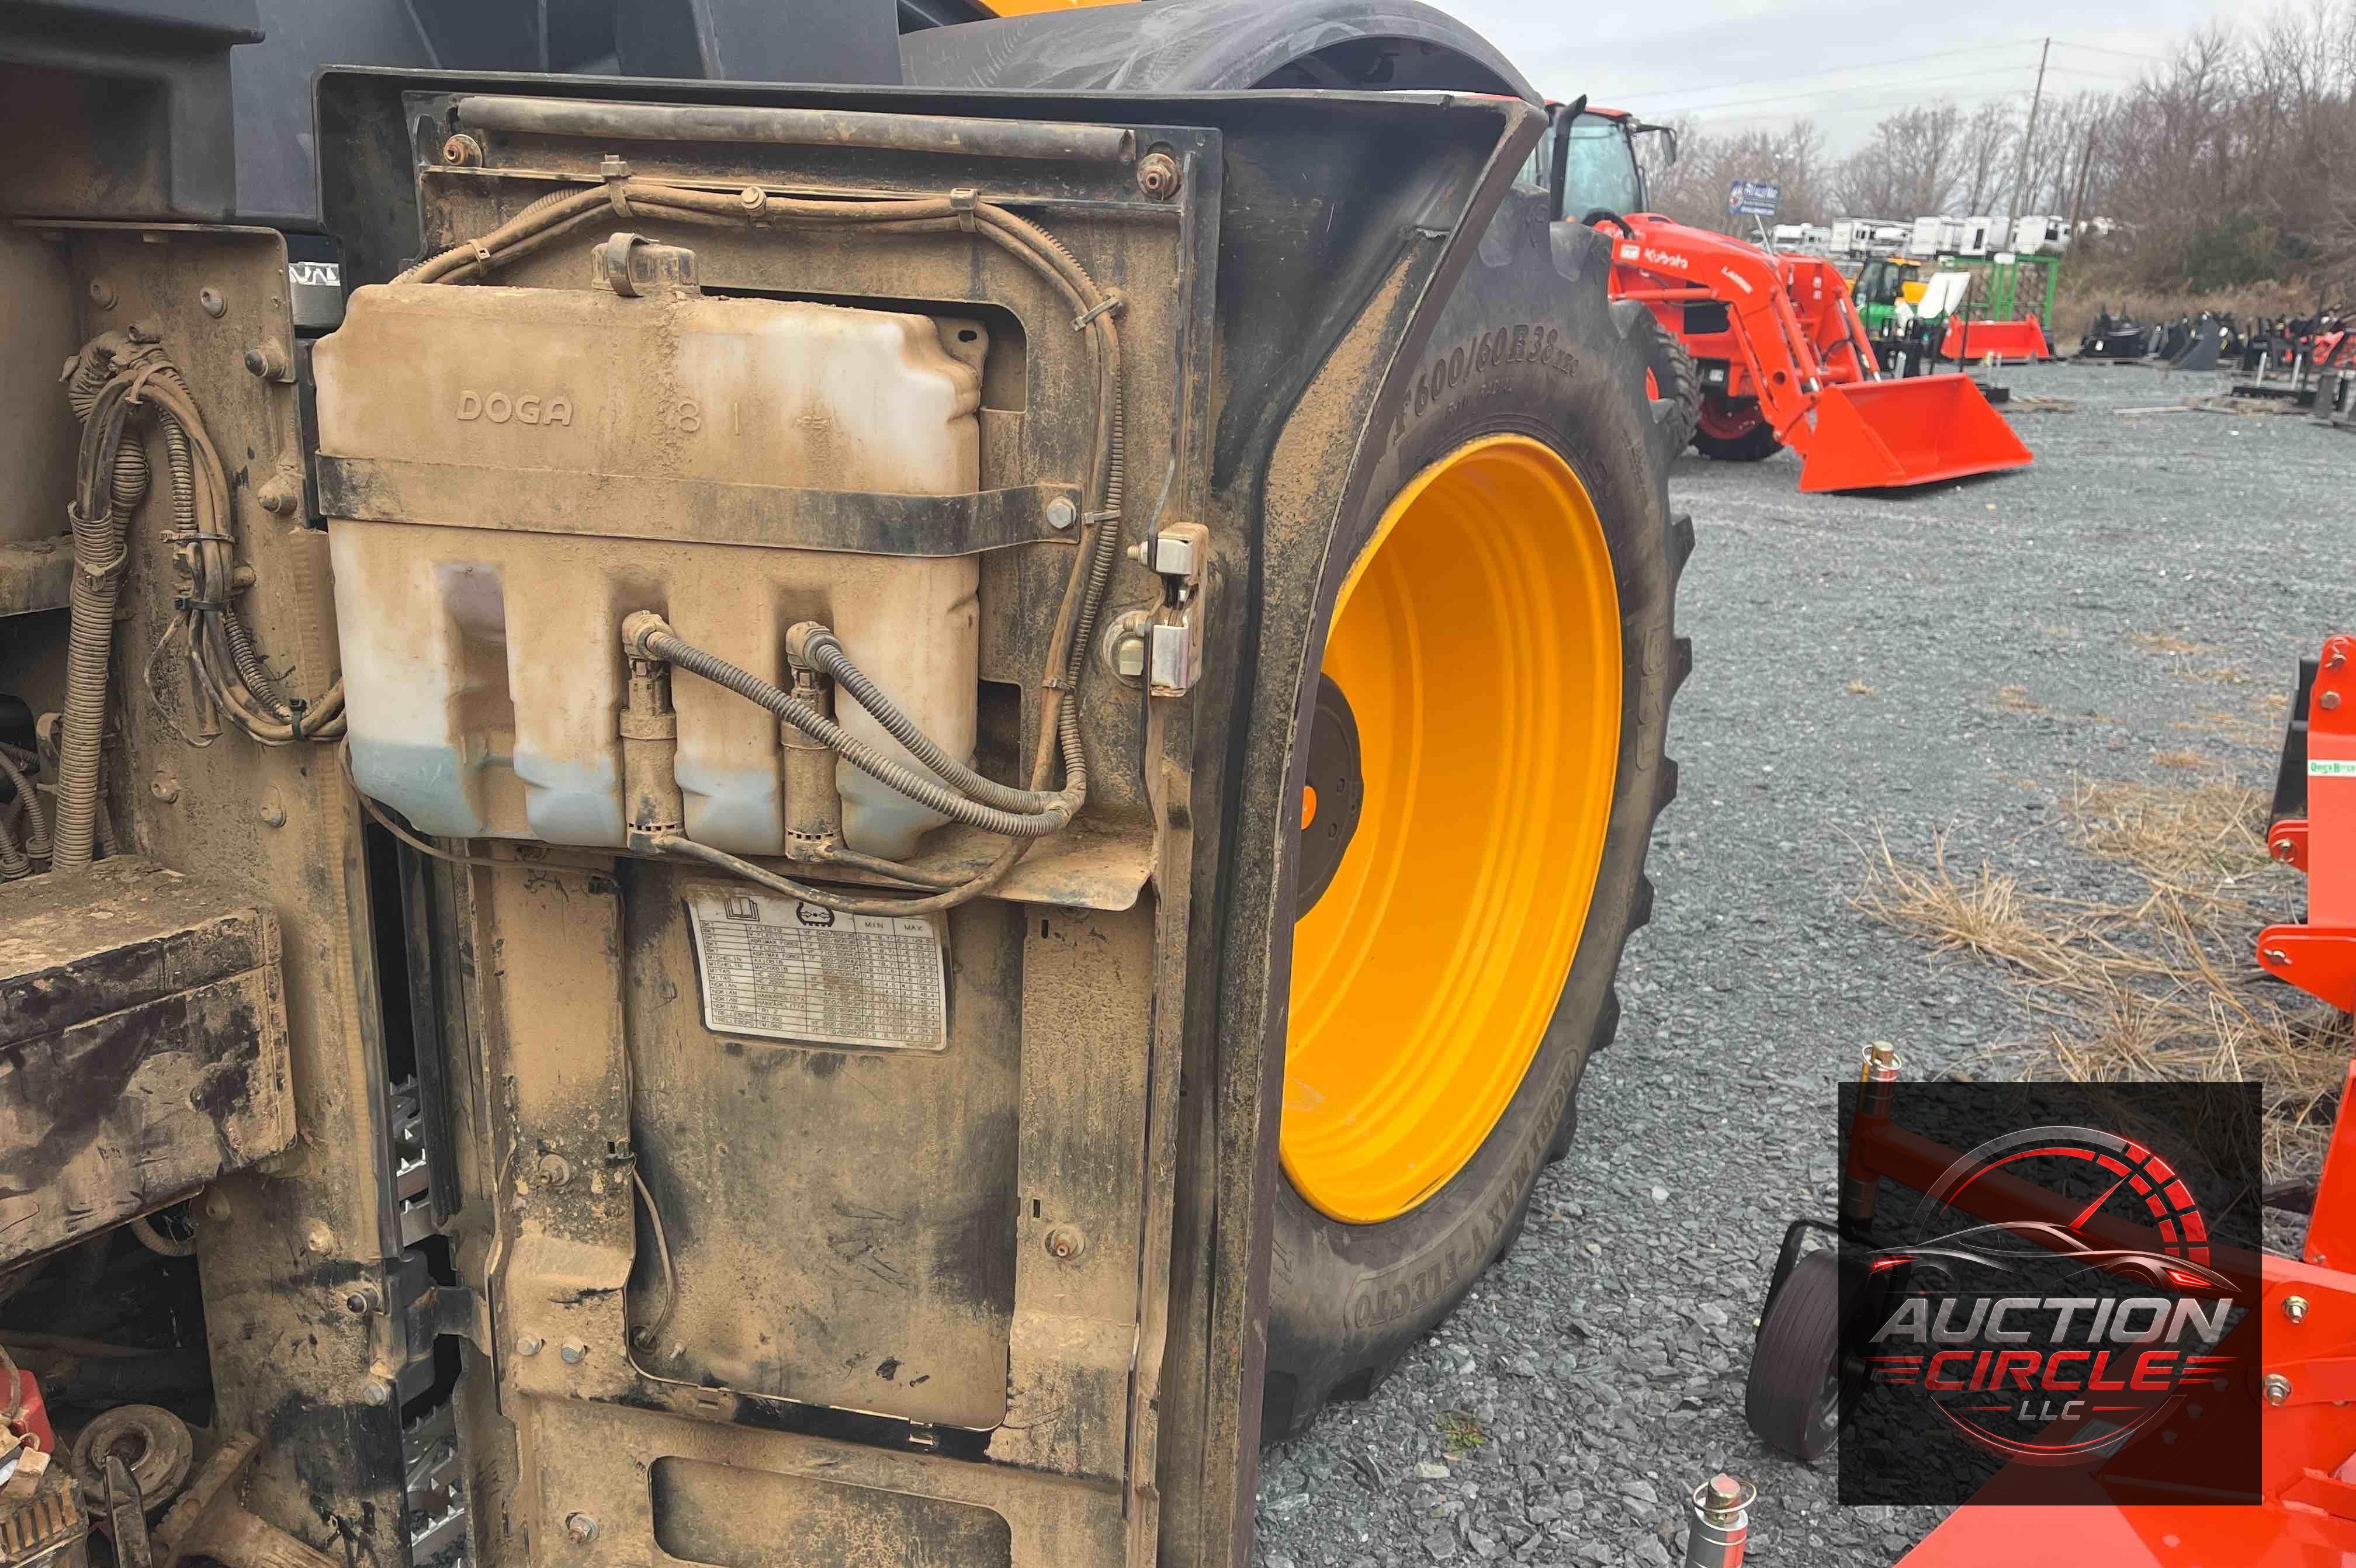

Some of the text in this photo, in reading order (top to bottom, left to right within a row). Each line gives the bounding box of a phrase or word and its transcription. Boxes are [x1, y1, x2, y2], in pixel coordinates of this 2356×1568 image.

[1643, 247, 1689, 270] Kubota
[457, 390, 574, 426] DOGA
[677, 400, 701, 433] 8
[1354, 1226, 1488, 1328] V-FLECTO
